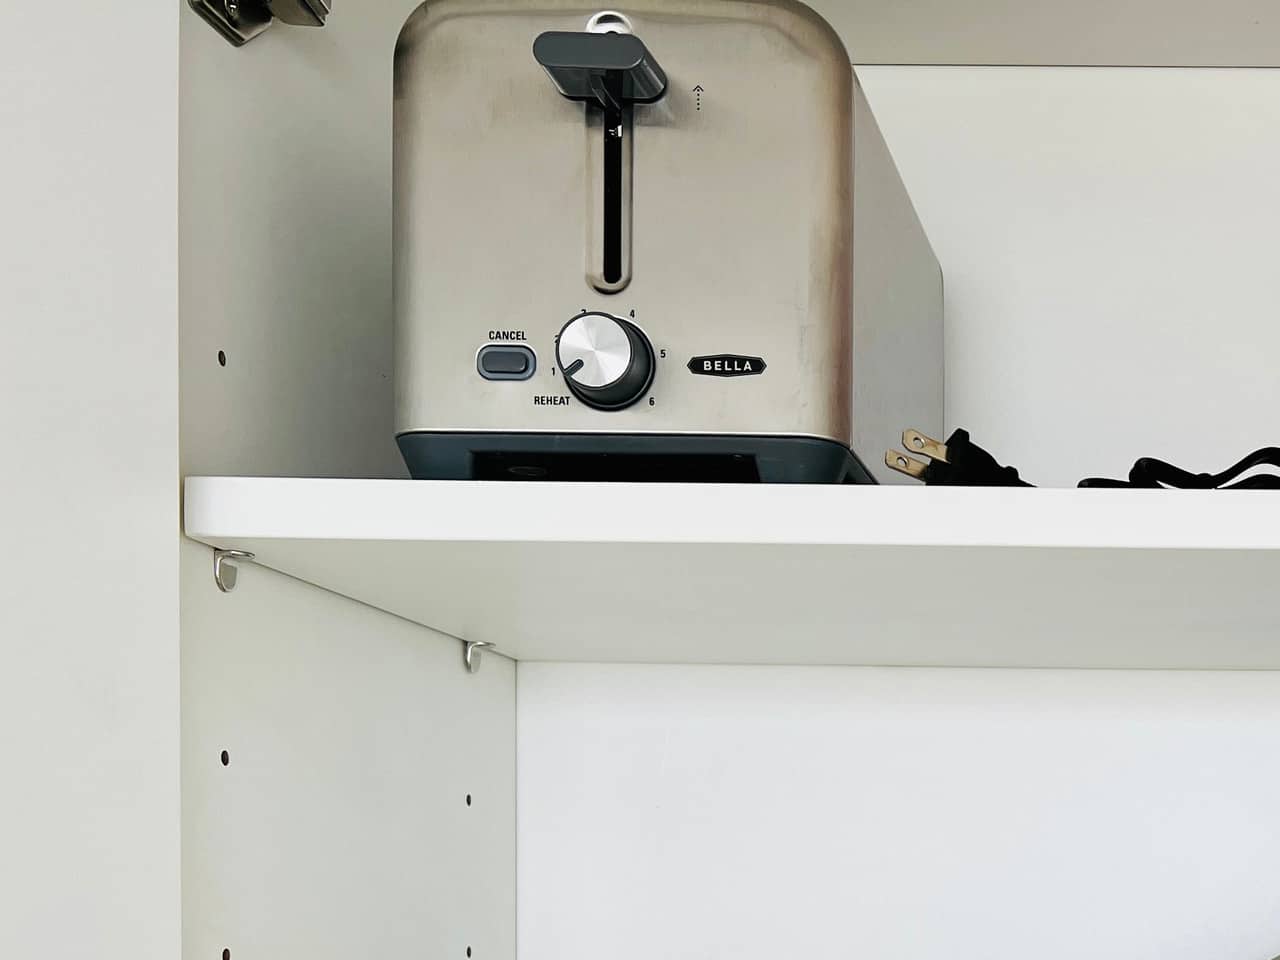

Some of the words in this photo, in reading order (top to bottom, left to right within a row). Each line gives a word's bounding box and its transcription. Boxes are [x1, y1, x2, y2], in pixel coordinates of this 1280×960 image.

[629, 309, 635, 318] 4
[488, 330, 527, 340] CANCEL
[660, 349, 666, 358] 5
[703, 360, 752, 371] BELLA
[551, 367, 556, 376] 1
[534, 395, 570, 406] REHEAT
[648, 397, 655, 406] 6
